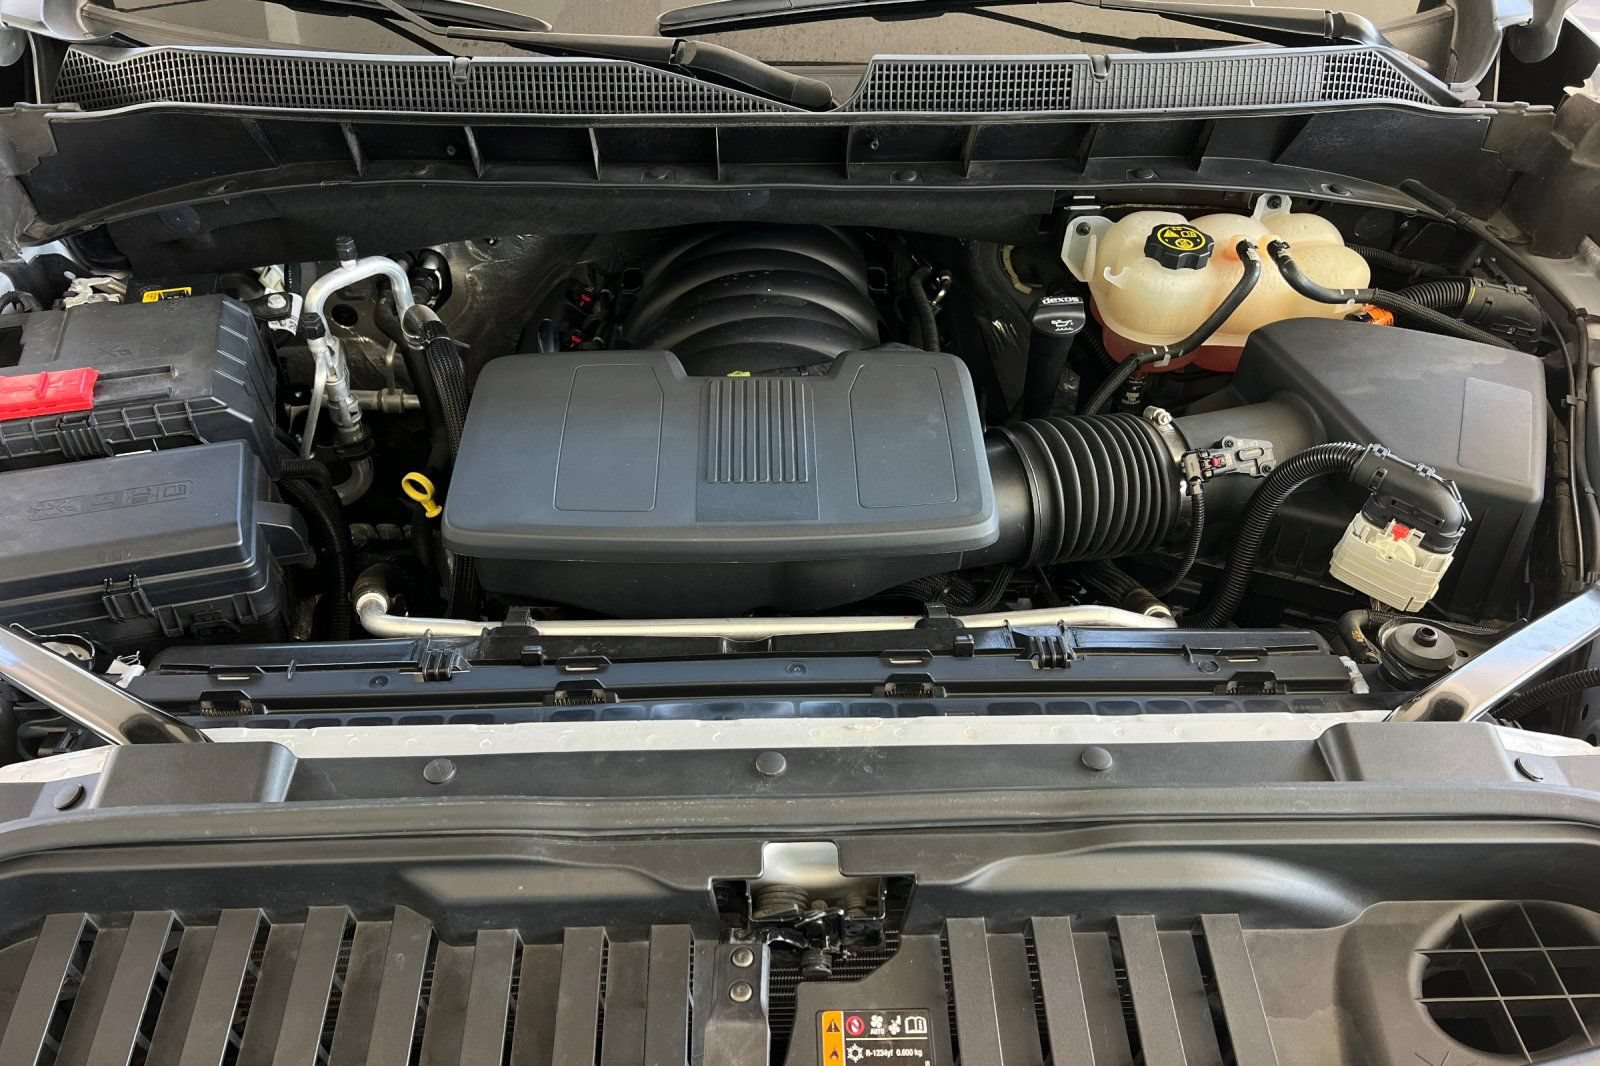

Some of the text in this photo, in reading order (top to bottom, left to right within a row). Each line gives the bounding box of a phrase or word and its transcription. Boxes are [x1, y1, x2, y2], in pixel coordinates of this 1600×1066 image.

[1041, 296, 1079, 304] dexos
[866, 1049, 893, 1058] R-1234yf
[914, 1049, 923, 1057] kg
